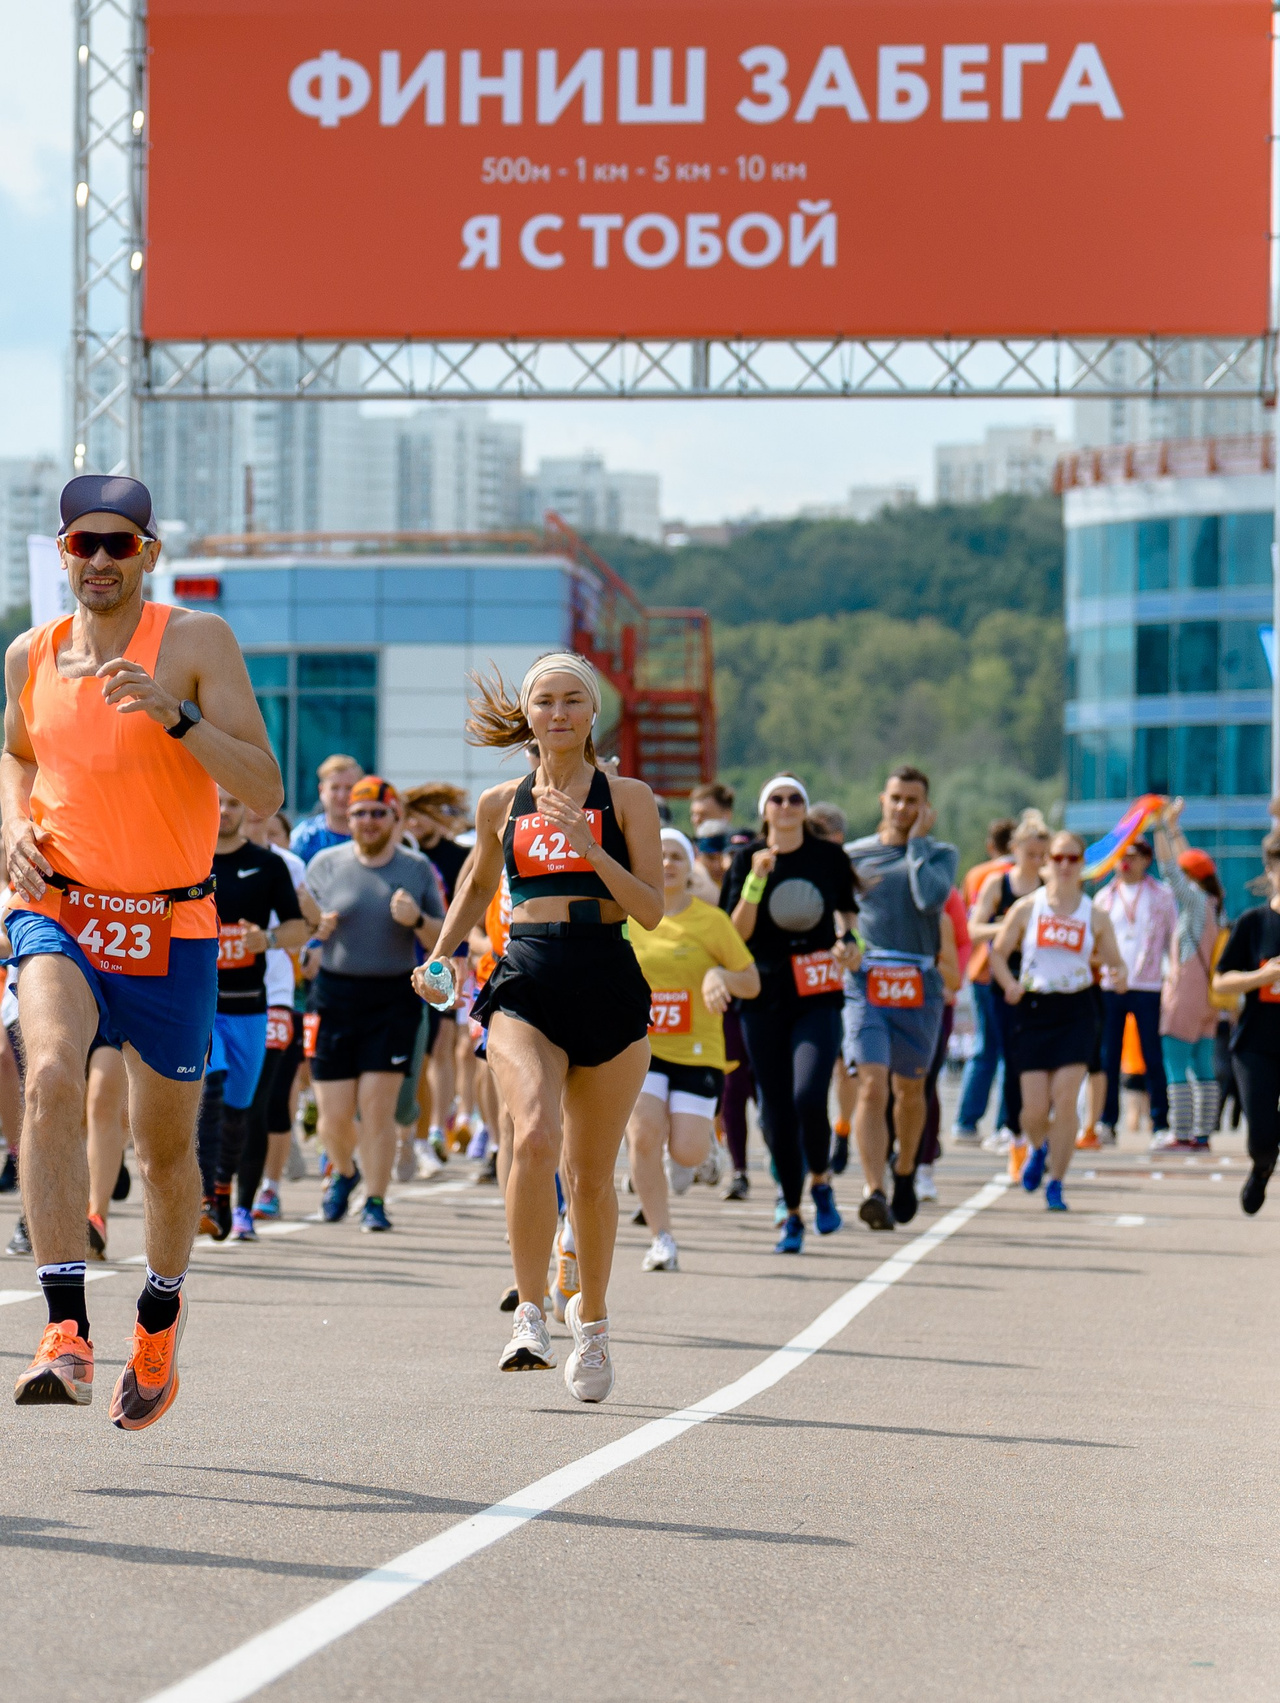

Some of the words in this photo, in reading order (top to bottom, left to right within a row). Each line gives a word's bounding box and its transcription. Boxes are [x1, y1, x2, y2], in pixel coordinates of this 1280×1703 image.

[288, 46, 707, 128] ФИНИШ
[736, 42, 1125, 124] ЗАБЕГА
[481, 156, 551, 183] 500м
[575, 157, 587, 182] 1
[593, 162, 629, 182] км
[653, 155, 671, 182] 5
[675, 162, 712, 182] км
[735, 154, 767, 182] 10
[771, 162, 808, 181] км
[460, 215, 501, 270] Я
[520, 214, 565, 270] С
[578, 200, 838, 269] ТОБОЙ
[520, 818, 529, 831] Я
[531, 816, 540, 828] С
[547, 863, 555, 871] 10
[69, 890, 80, 905] Я
[83, 893, 95, 908] С
[98, 894, 165, 915] ТОБОЙ
[77, 918, 151, 960] 423
[99, 960, 110, 970] 10
[877, 979, 916, 1000] 364
[649, 1004, 681, 1027] 75
